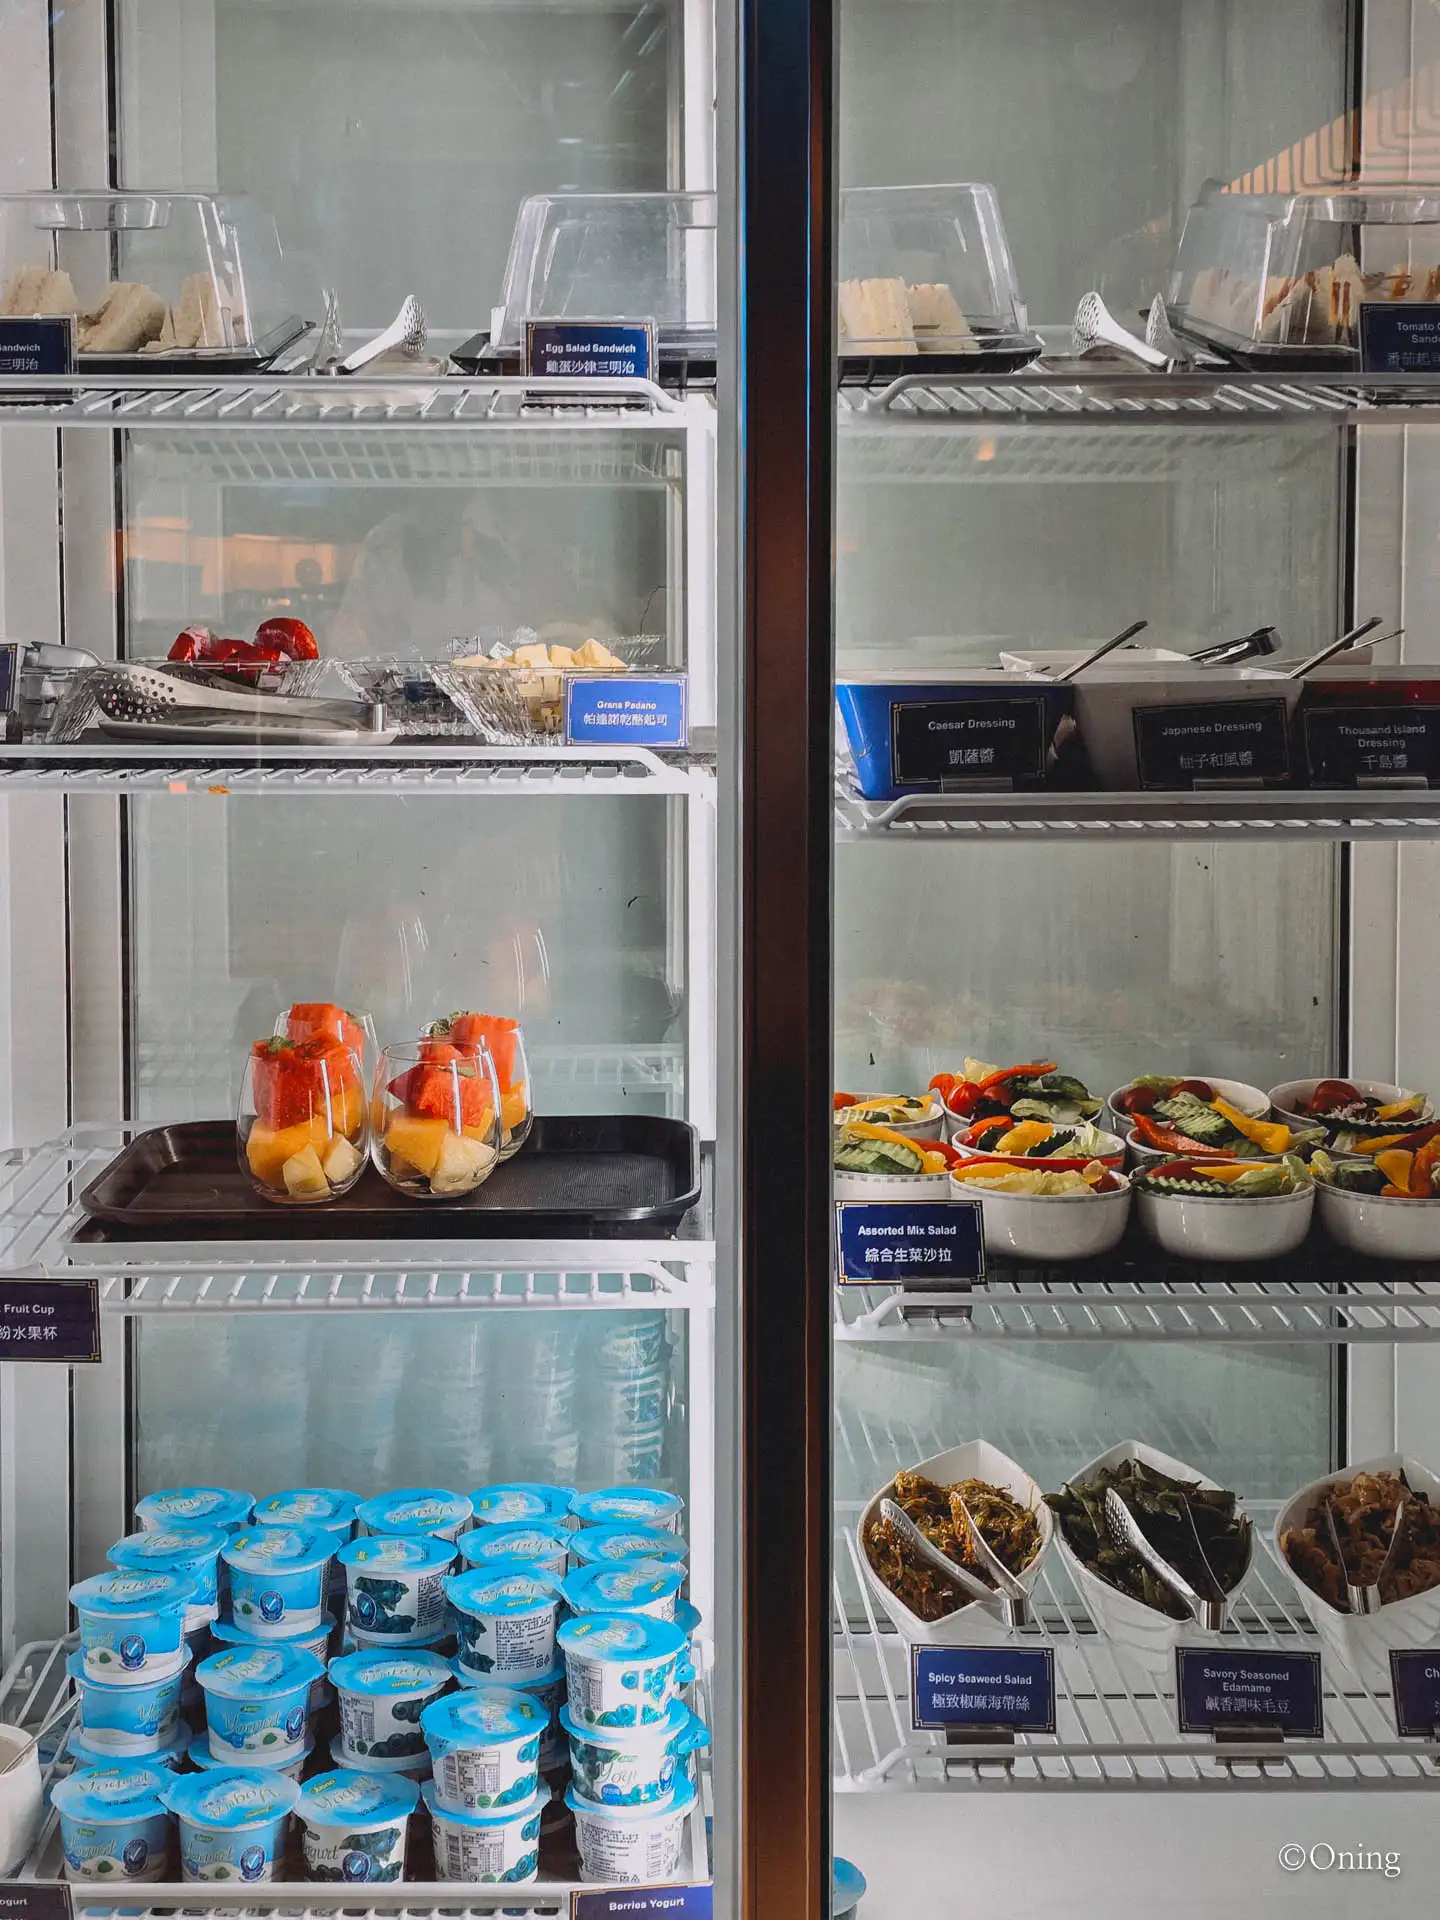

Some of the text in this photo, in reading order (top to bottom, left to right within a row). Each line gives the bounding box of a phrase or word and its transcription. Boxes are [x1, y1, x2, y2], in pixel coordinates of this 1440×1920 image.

[1396, 321, 1435, 332] Tomato
[545, 343, 636, 355] Egg Salad Sandwich
[597, 700, 657, 711] Grana Padano
[928, 718, 1016, 731] Caesar Dressing
[1162, 721, 1263, 737] Japanese Dressing
[1338, 724, 1426, 735] Thousand Island
[1358, 738, 1406, 749] Dressing
[949, 748, 995, 765] 凱薩醬
[1360, 753, 1409, 770] 千島醬
[858, 1225, 957, 1236] Assorted Mix Salad
[864, 1247, 953, 1263] 綜合生菜沙拉
[4, 1303, 55, 1316] Fruit Cup
[928, 1672, 1032, 1685] Spicy Seaweed Salad
[1203, 1667, 1290, 1681] Savory Seasoned
[1222, 1682, 1272, 1693] Edamame
[931, 1692, 1031, 1711] 極致椒麻海帶絲
[609, 1896, 685, 1911] Berries Yogurt
